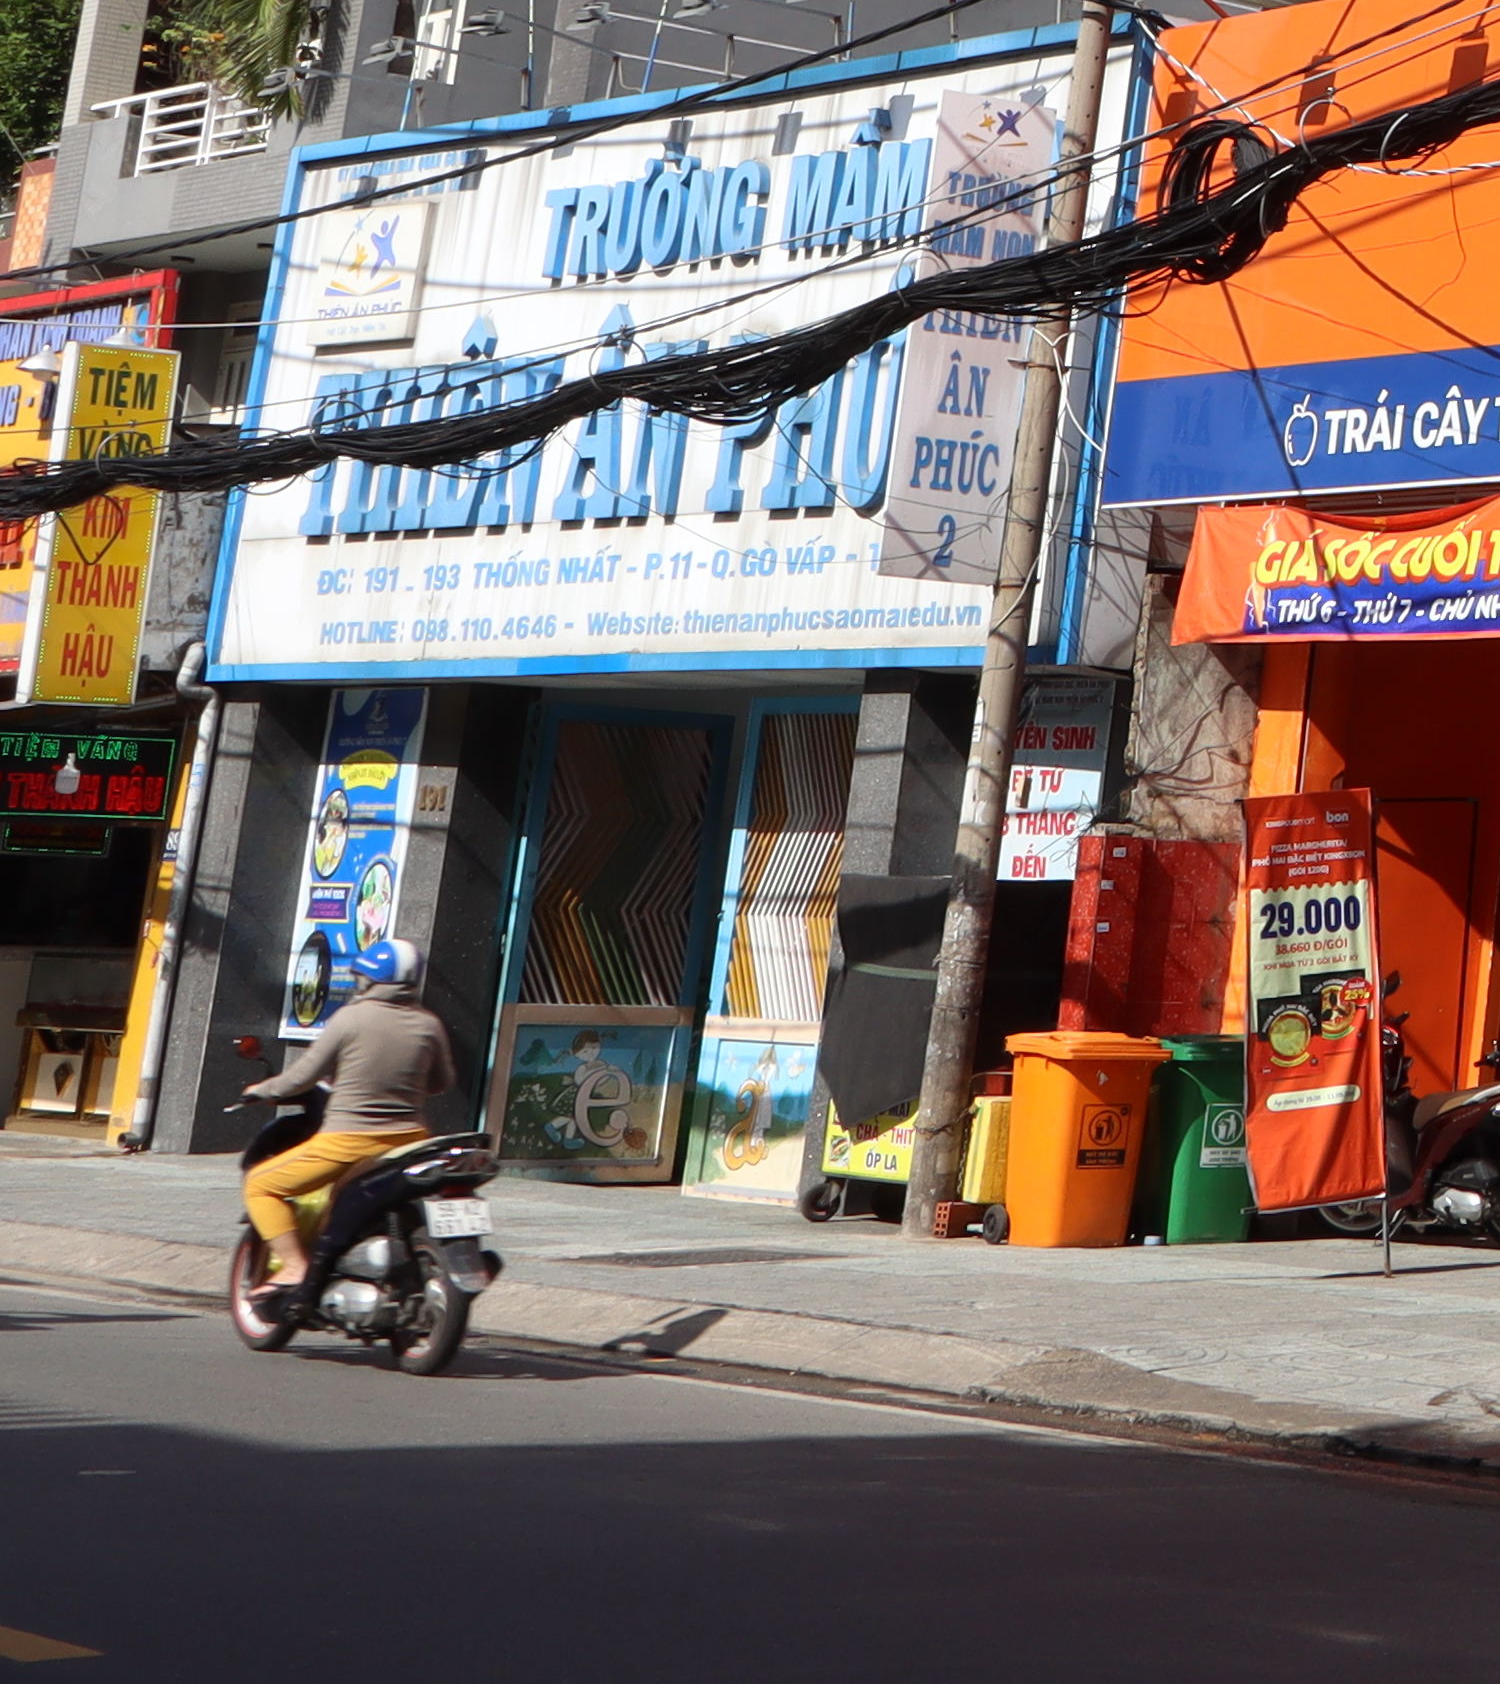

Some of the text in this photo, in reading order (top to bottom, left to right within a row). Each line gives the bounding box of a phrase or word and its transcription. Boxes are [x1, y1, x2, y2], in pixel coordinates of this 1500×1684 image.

[541, 140, 769, 284] TRƯỜNG
[88, 361, 159, 417] TIỆM
[937, 350, 991, 418] ÂN
[1325, 388, 1402, 456] TRÁI
[1413, 384, 1487, 449] CÂY
[909, 430, 1001, 497] PHÚC
[82, 496, 131, 540] KIM
[931, 513, 957, 569] 2
[364, 565, 399, 593] 191
[424, 563, 461, 591] 193
[474, 550, 550, 589] THỐNG
[557, 544, 622, 584] NHẤT
[786, 535, 837, 576] VẤP
[1254, 528, 1320, 584] GIÁ
[1325, 526, 1397, 582] SỐC
[1393, 514, 1480, 579] CUỐI
[56, 551, 141, 609] THÀNH
[411, 614, 558, 643] 098.110.4646
[1275, 592, 1321, 625] THỨ
[1320, 597, 1334, 624] 6
[1353, 590, 1398, 625] THỨ
[1399, 593, 1413, 624] 7
[1429, 589, 1476, 623] CHỦ
[60, 623, 114, 688] HẬU
[1052, 725, 1097, 751] SINH
[105, 765, 165, 816] HẬU
[419, 783, 447, 814] 191
[1015, 805, 1077, 836] THÁNG
[1011, 843, 1048, 879] ĐẾN
[1259, 894, 1362, 941] 29.000
[884, 1153, 898, 1171] LA
